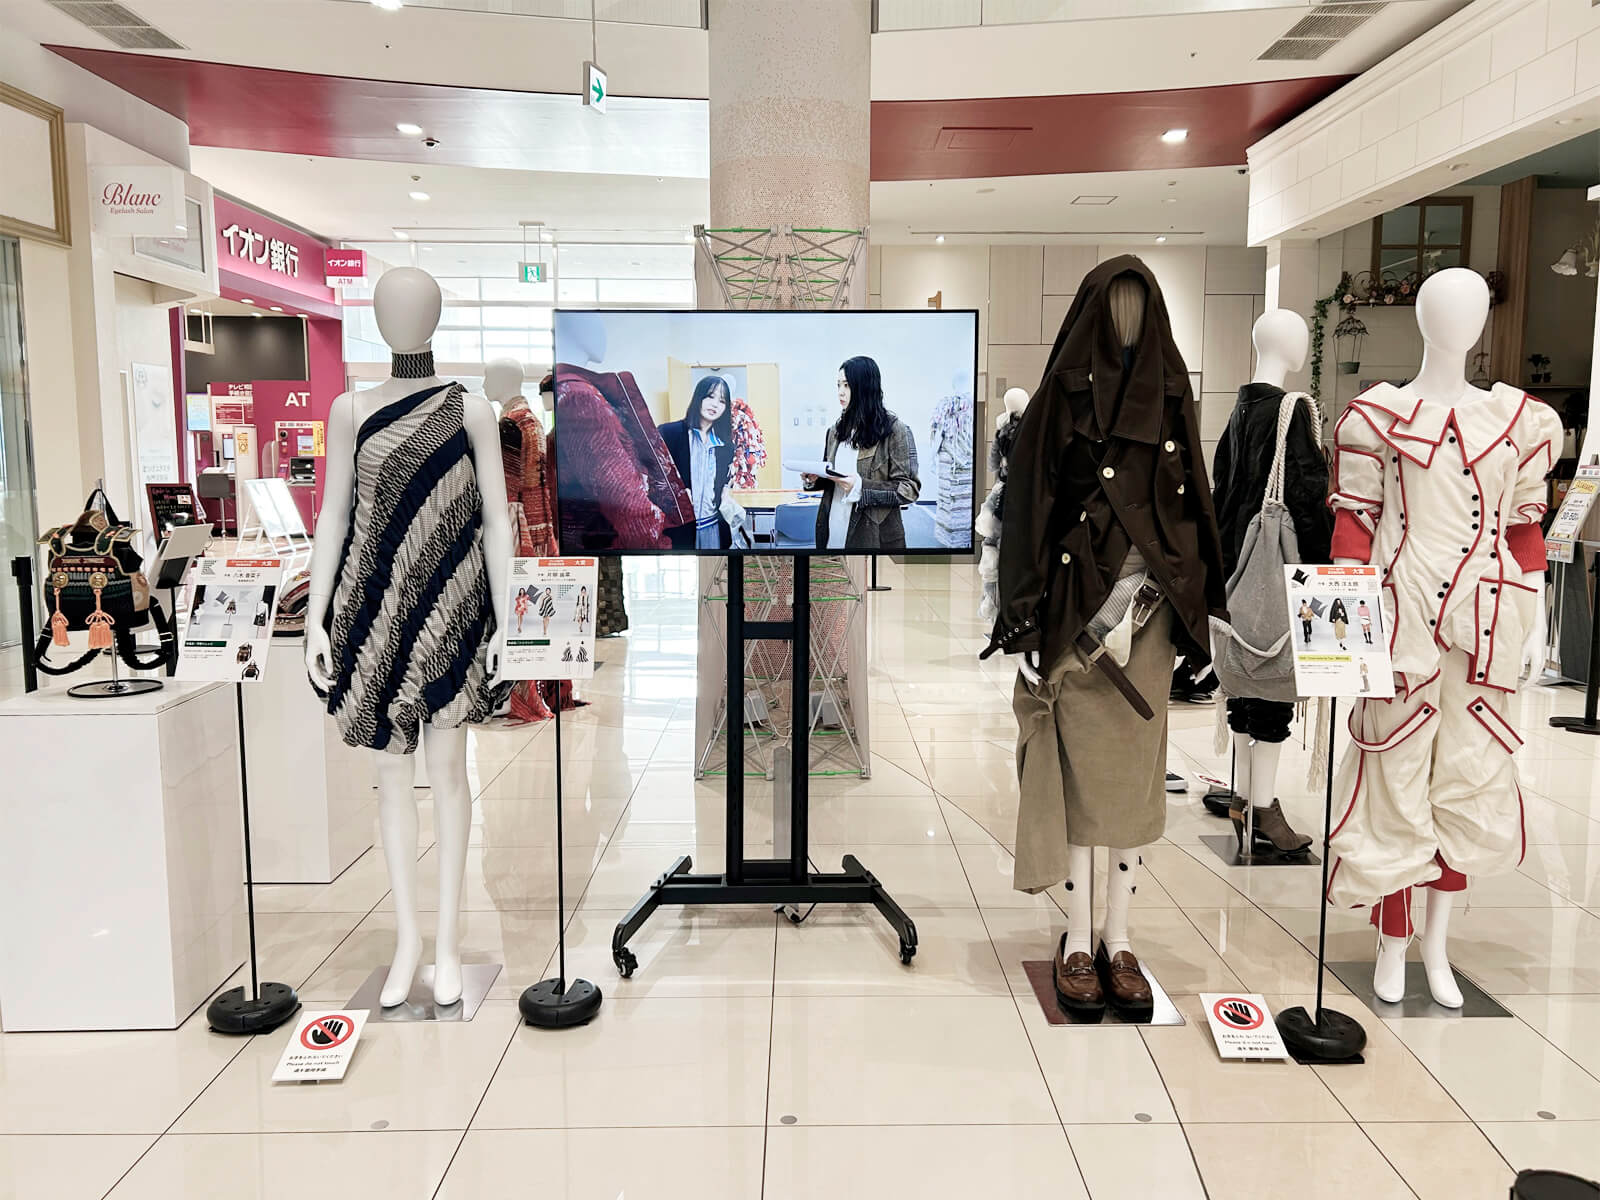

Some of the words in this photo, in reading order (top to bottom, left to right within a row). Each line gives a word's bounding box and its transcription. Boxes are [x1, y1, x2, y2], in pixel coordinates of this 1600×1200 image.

[102, 182, 161, 206] Blanc
[110, 207, 135, 215] Eyelash
[136, 207, 154, 215] Salon
[222, 224, 299, 278] イオン銀行
[328, 259, 361, 267] イオン銀行
[338, 277, 353, 285] ATM
[285, 392, 310, 407] AT
